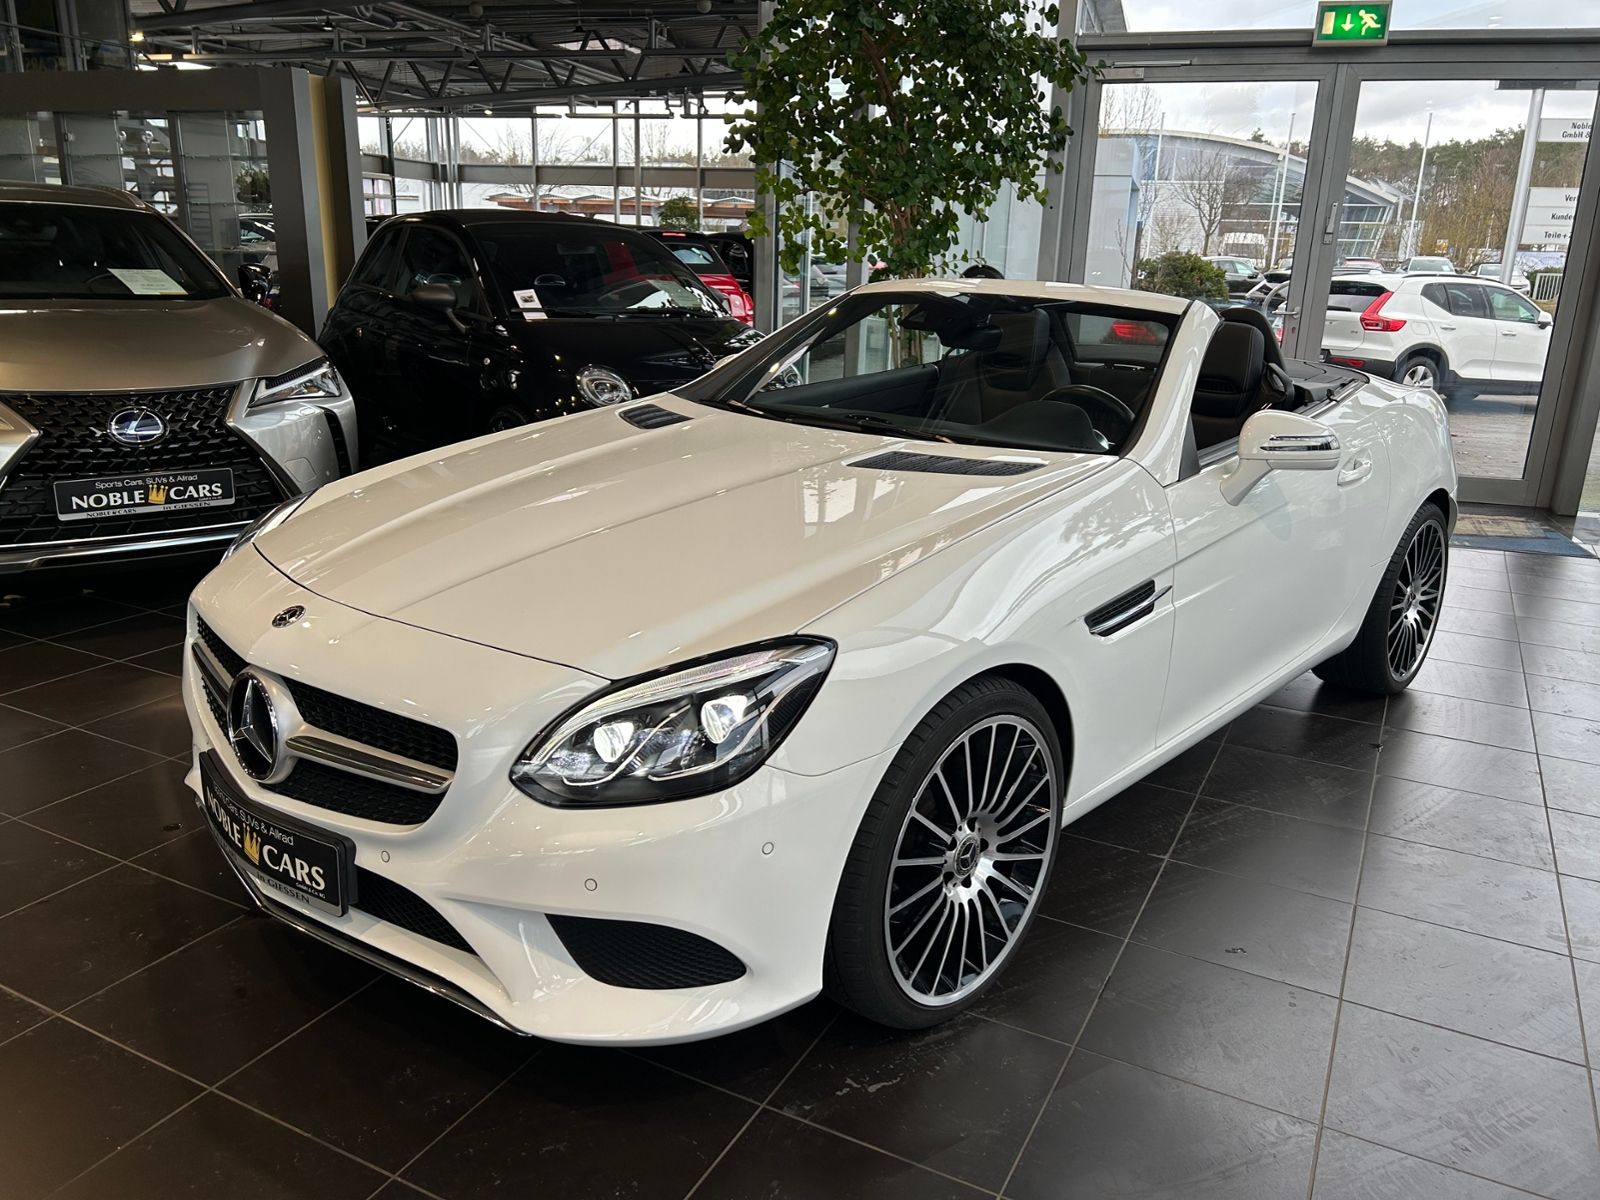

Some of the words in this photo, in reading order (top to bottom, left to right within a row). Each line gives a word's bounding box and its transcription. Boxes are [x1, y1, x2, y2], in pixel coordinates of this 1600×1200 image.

[1544, 231, 1562, 239] Teile
[95, 481, 123, 490] Sports
[146, 476, 168, 486] SUVs
[176, 474, 198, 482] Allrad
[71, 490, 145, 510] NOBLE
[169, 483, 223, 500] CARS
[206, 786, 242, 848] NOBLE
[262, 844, 326, 891] CARS
[240, 809, 260, 830] SUVs
[260, 822, 268, 834] &
[268, 827, 294, 846] Allrad
[267, 878, 310, 905] GIESSEN
